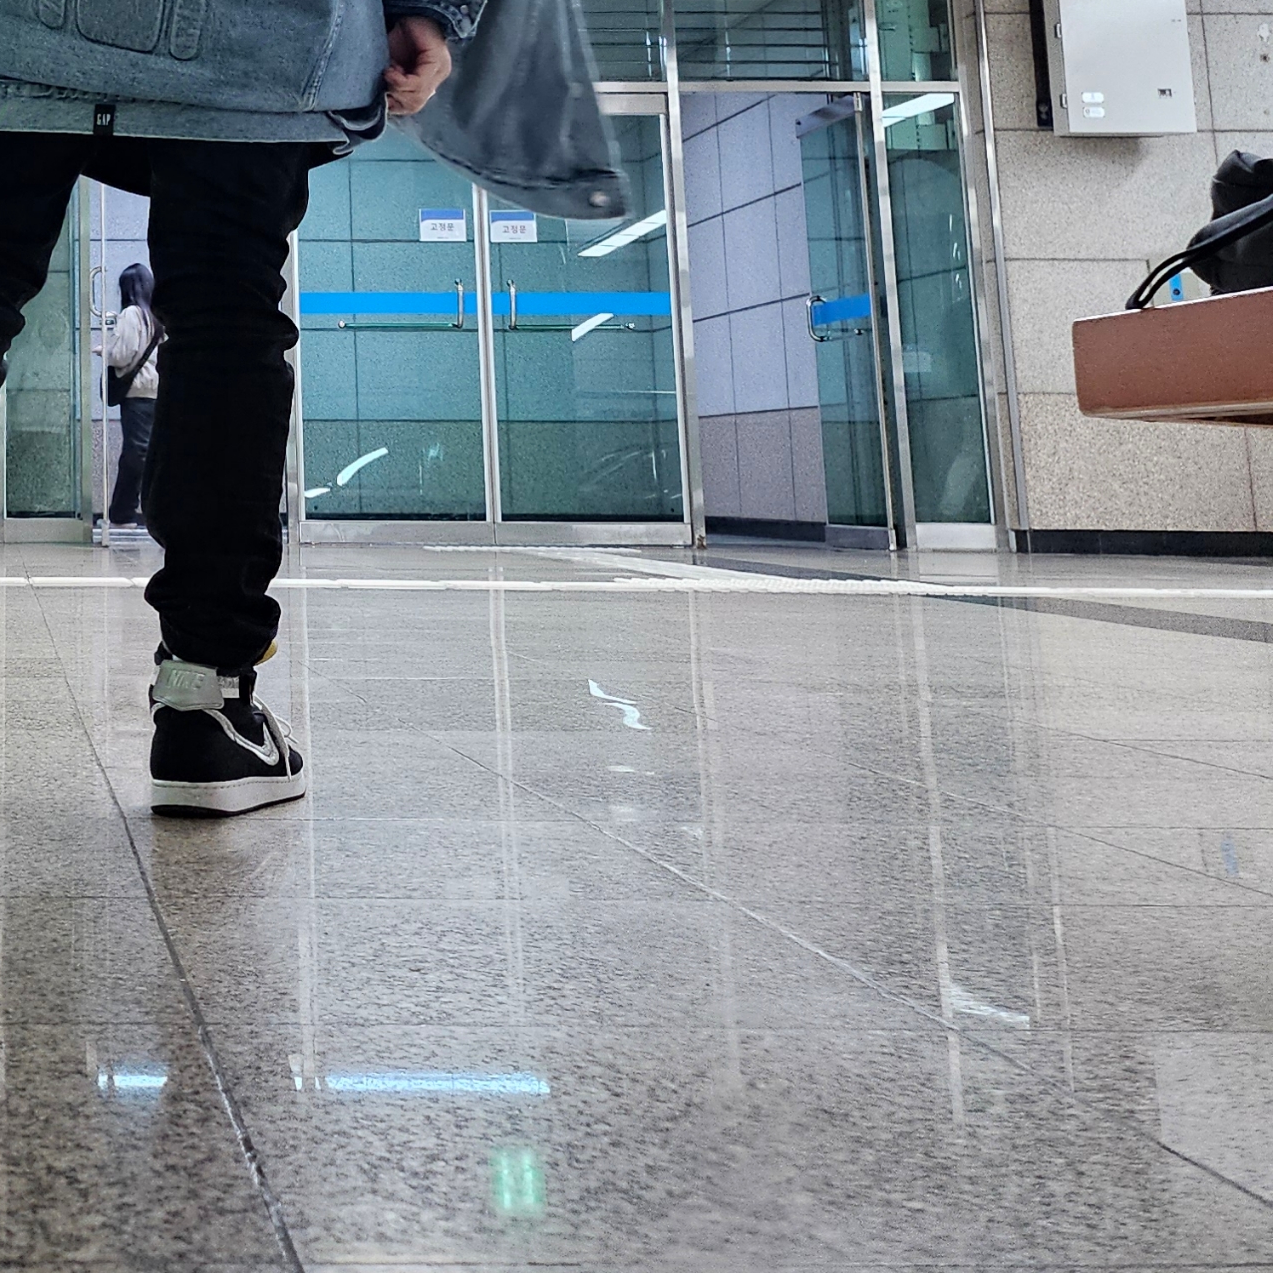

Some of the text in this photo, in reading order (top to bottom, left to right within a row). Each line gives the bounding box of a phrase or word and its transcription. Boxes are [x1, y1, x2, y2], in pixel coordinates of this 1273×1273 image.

[96, 113, 111, 126] GAP
[430, 222, 455, 232] 고정문
[502, 225, 527, 234] 고정문
